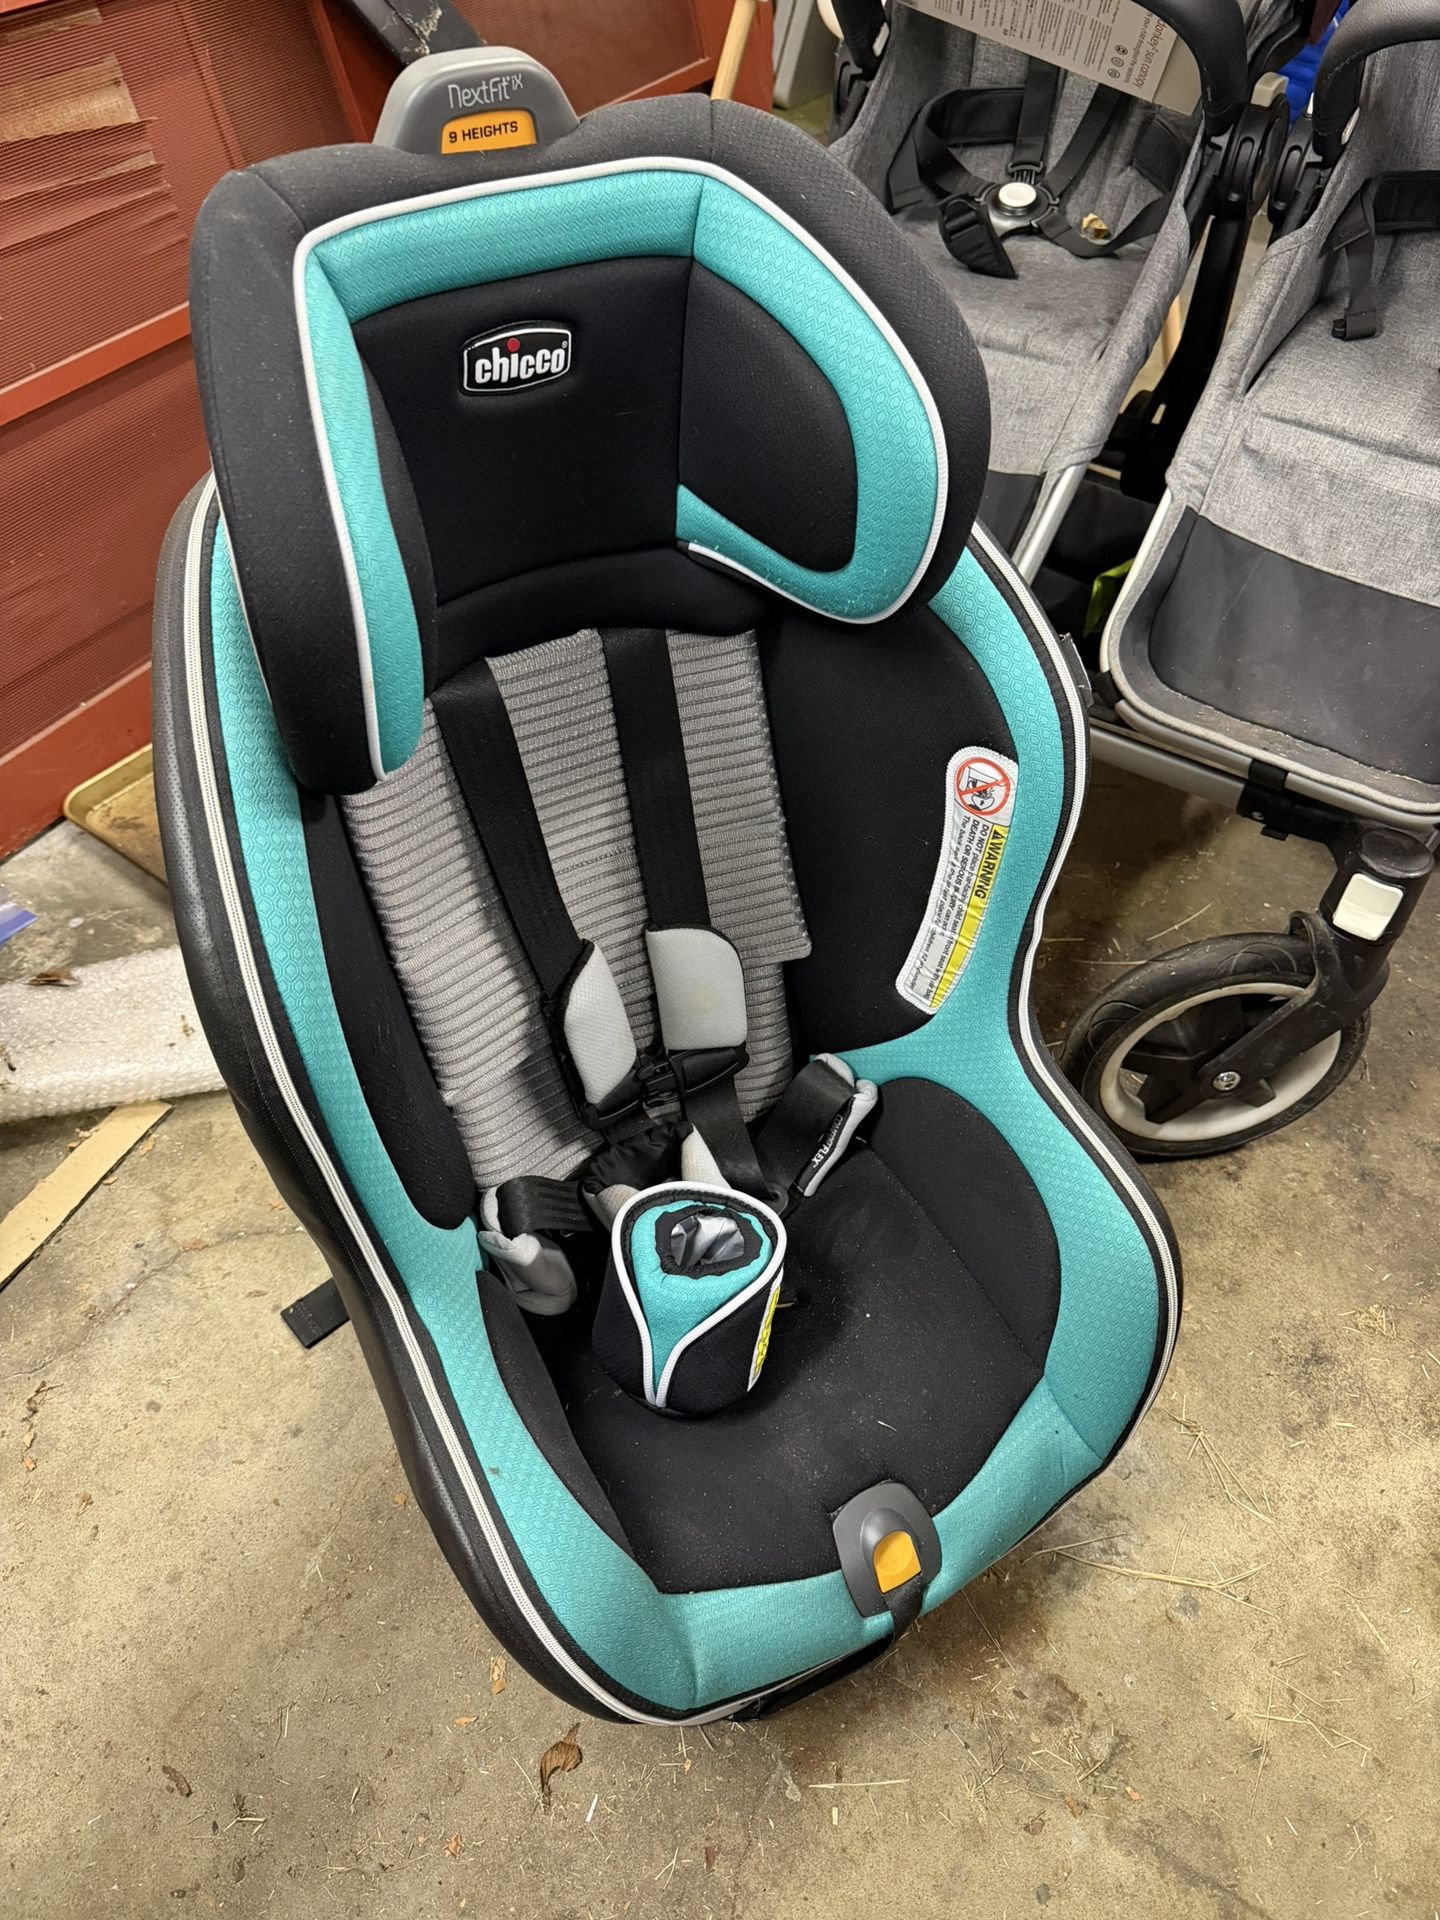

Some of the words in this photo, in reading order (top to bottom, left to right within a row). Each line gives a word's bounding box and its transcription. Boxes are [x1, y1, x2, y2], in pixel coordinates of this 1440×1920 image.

[449, 131, 458, 144] 9
[462, 121, 518, 142] HEIGHTS
[475, 337, 565, 384] chicco
[966, 819, 979, 844] DEATH
[979, 823, 989, 836] DO
[963, 844, 971, 855] OR
[974, 836, 985, 853] NOT
[954, 856, 968, 885] SEROUS
[974, 841, 1000, 899] WARNING
